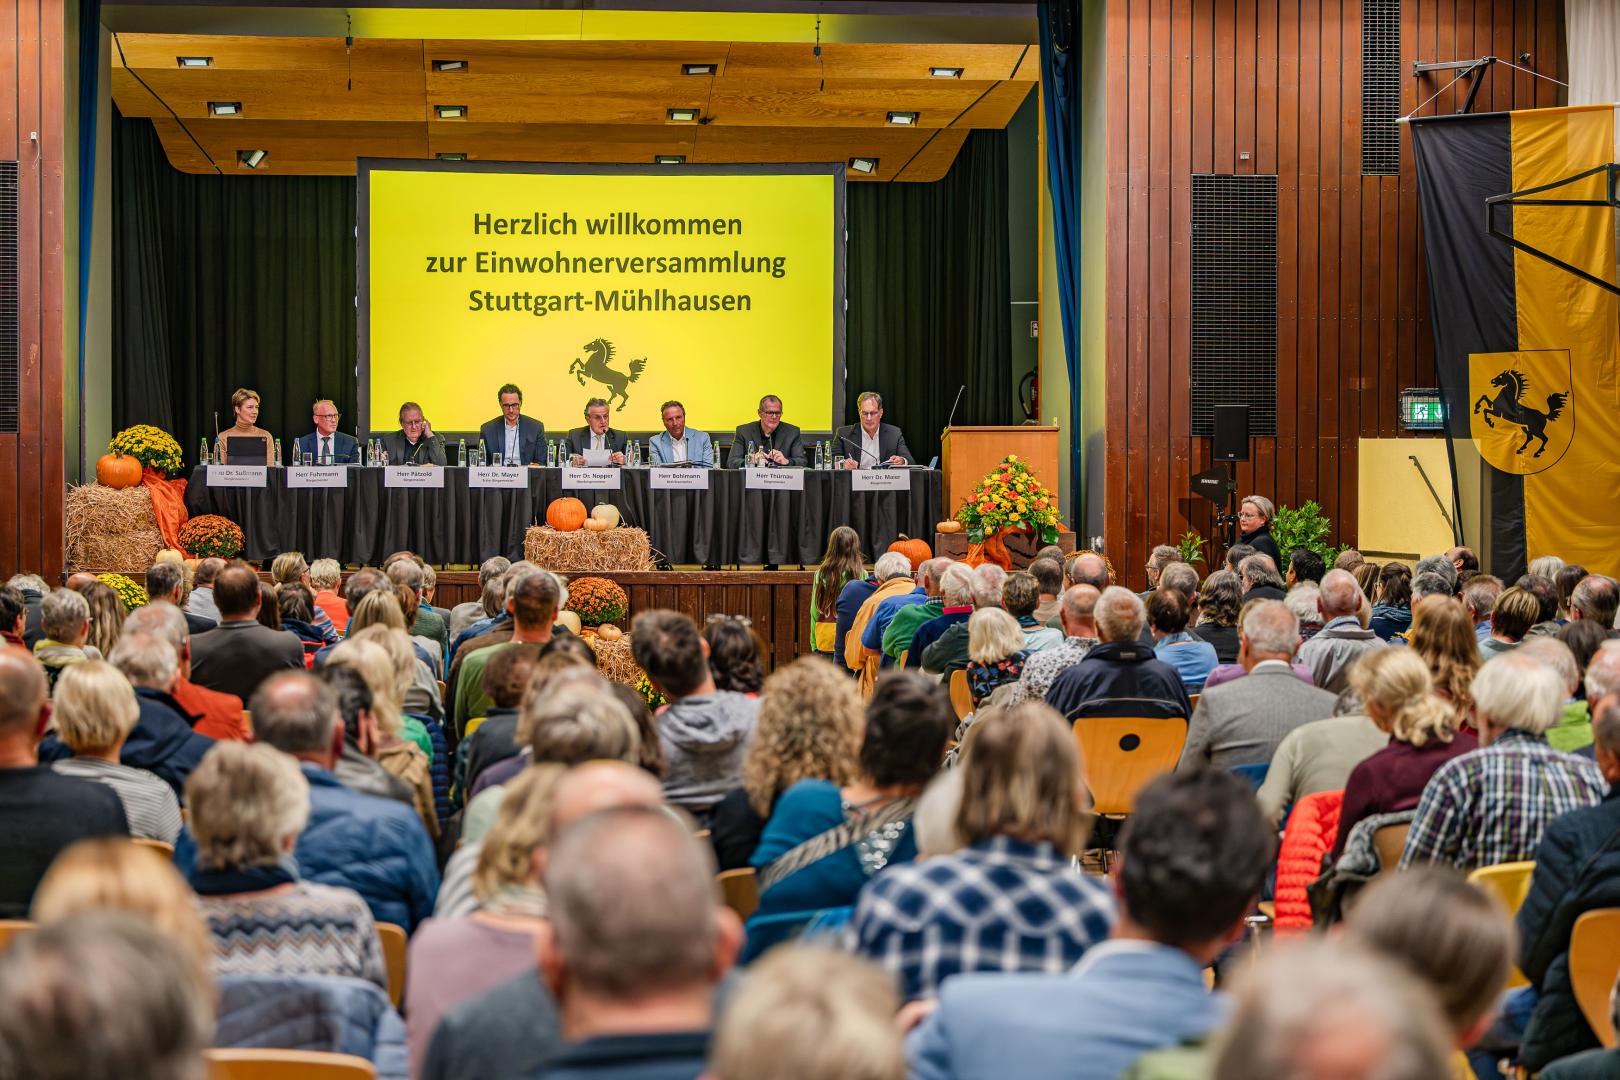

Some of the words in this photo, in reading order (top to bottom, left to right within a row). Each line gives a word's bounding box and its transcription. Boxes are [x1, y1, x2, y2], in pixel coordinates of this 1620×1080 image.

[473, 211, 578, 236] Herzlich
[586, 211, 743, 236] willkommen
[425, 255, 468, 274] zur
[475, 250, 787, 279] Einwohnerversammlung
[468, 289, 752, 317] Stuttgart-Mühlhausen
